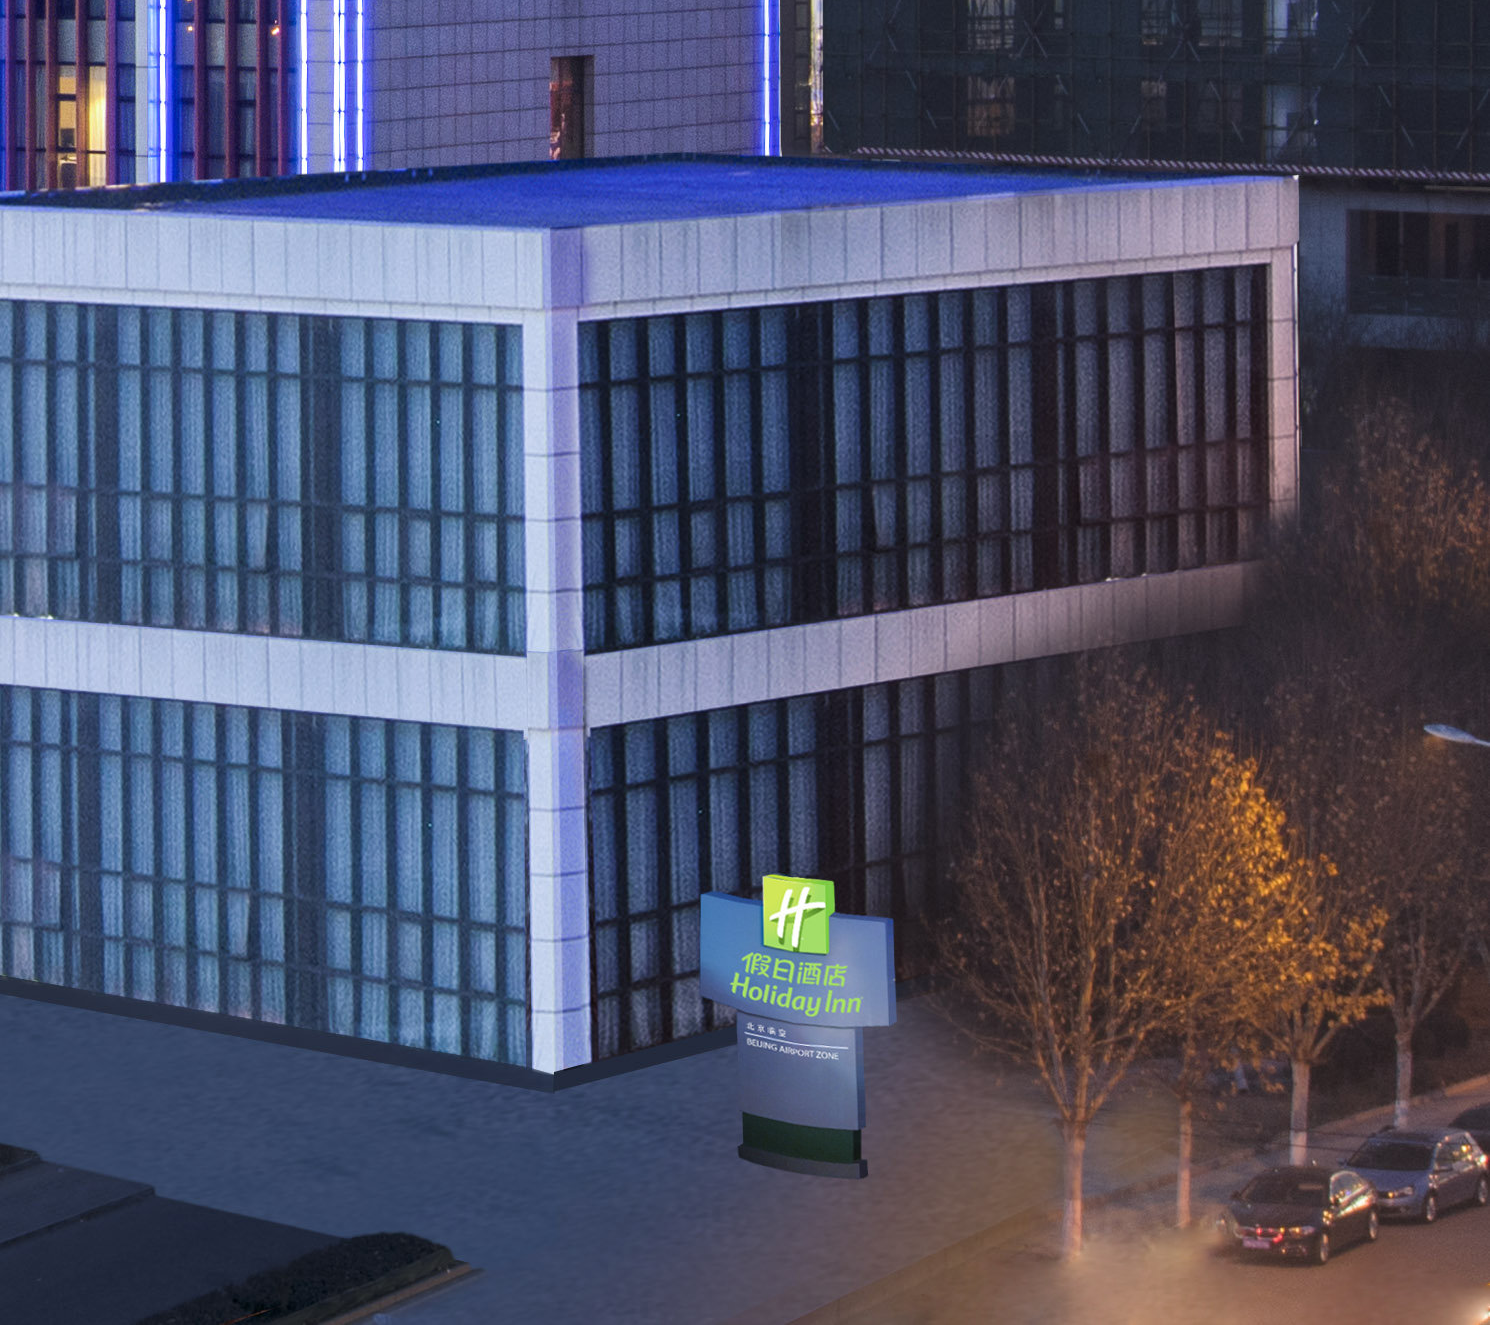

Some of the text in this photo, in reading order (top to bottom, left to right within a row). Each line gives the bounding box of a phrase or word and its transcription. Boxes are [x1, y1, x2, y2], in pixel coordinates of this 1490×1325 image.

[741, 952, 848, 987] 假日酒店
[730, 972, 862, 1017] Holiday Inn
[746, 1038, 839, 1060] BEIJING AIRPORT ZONE
